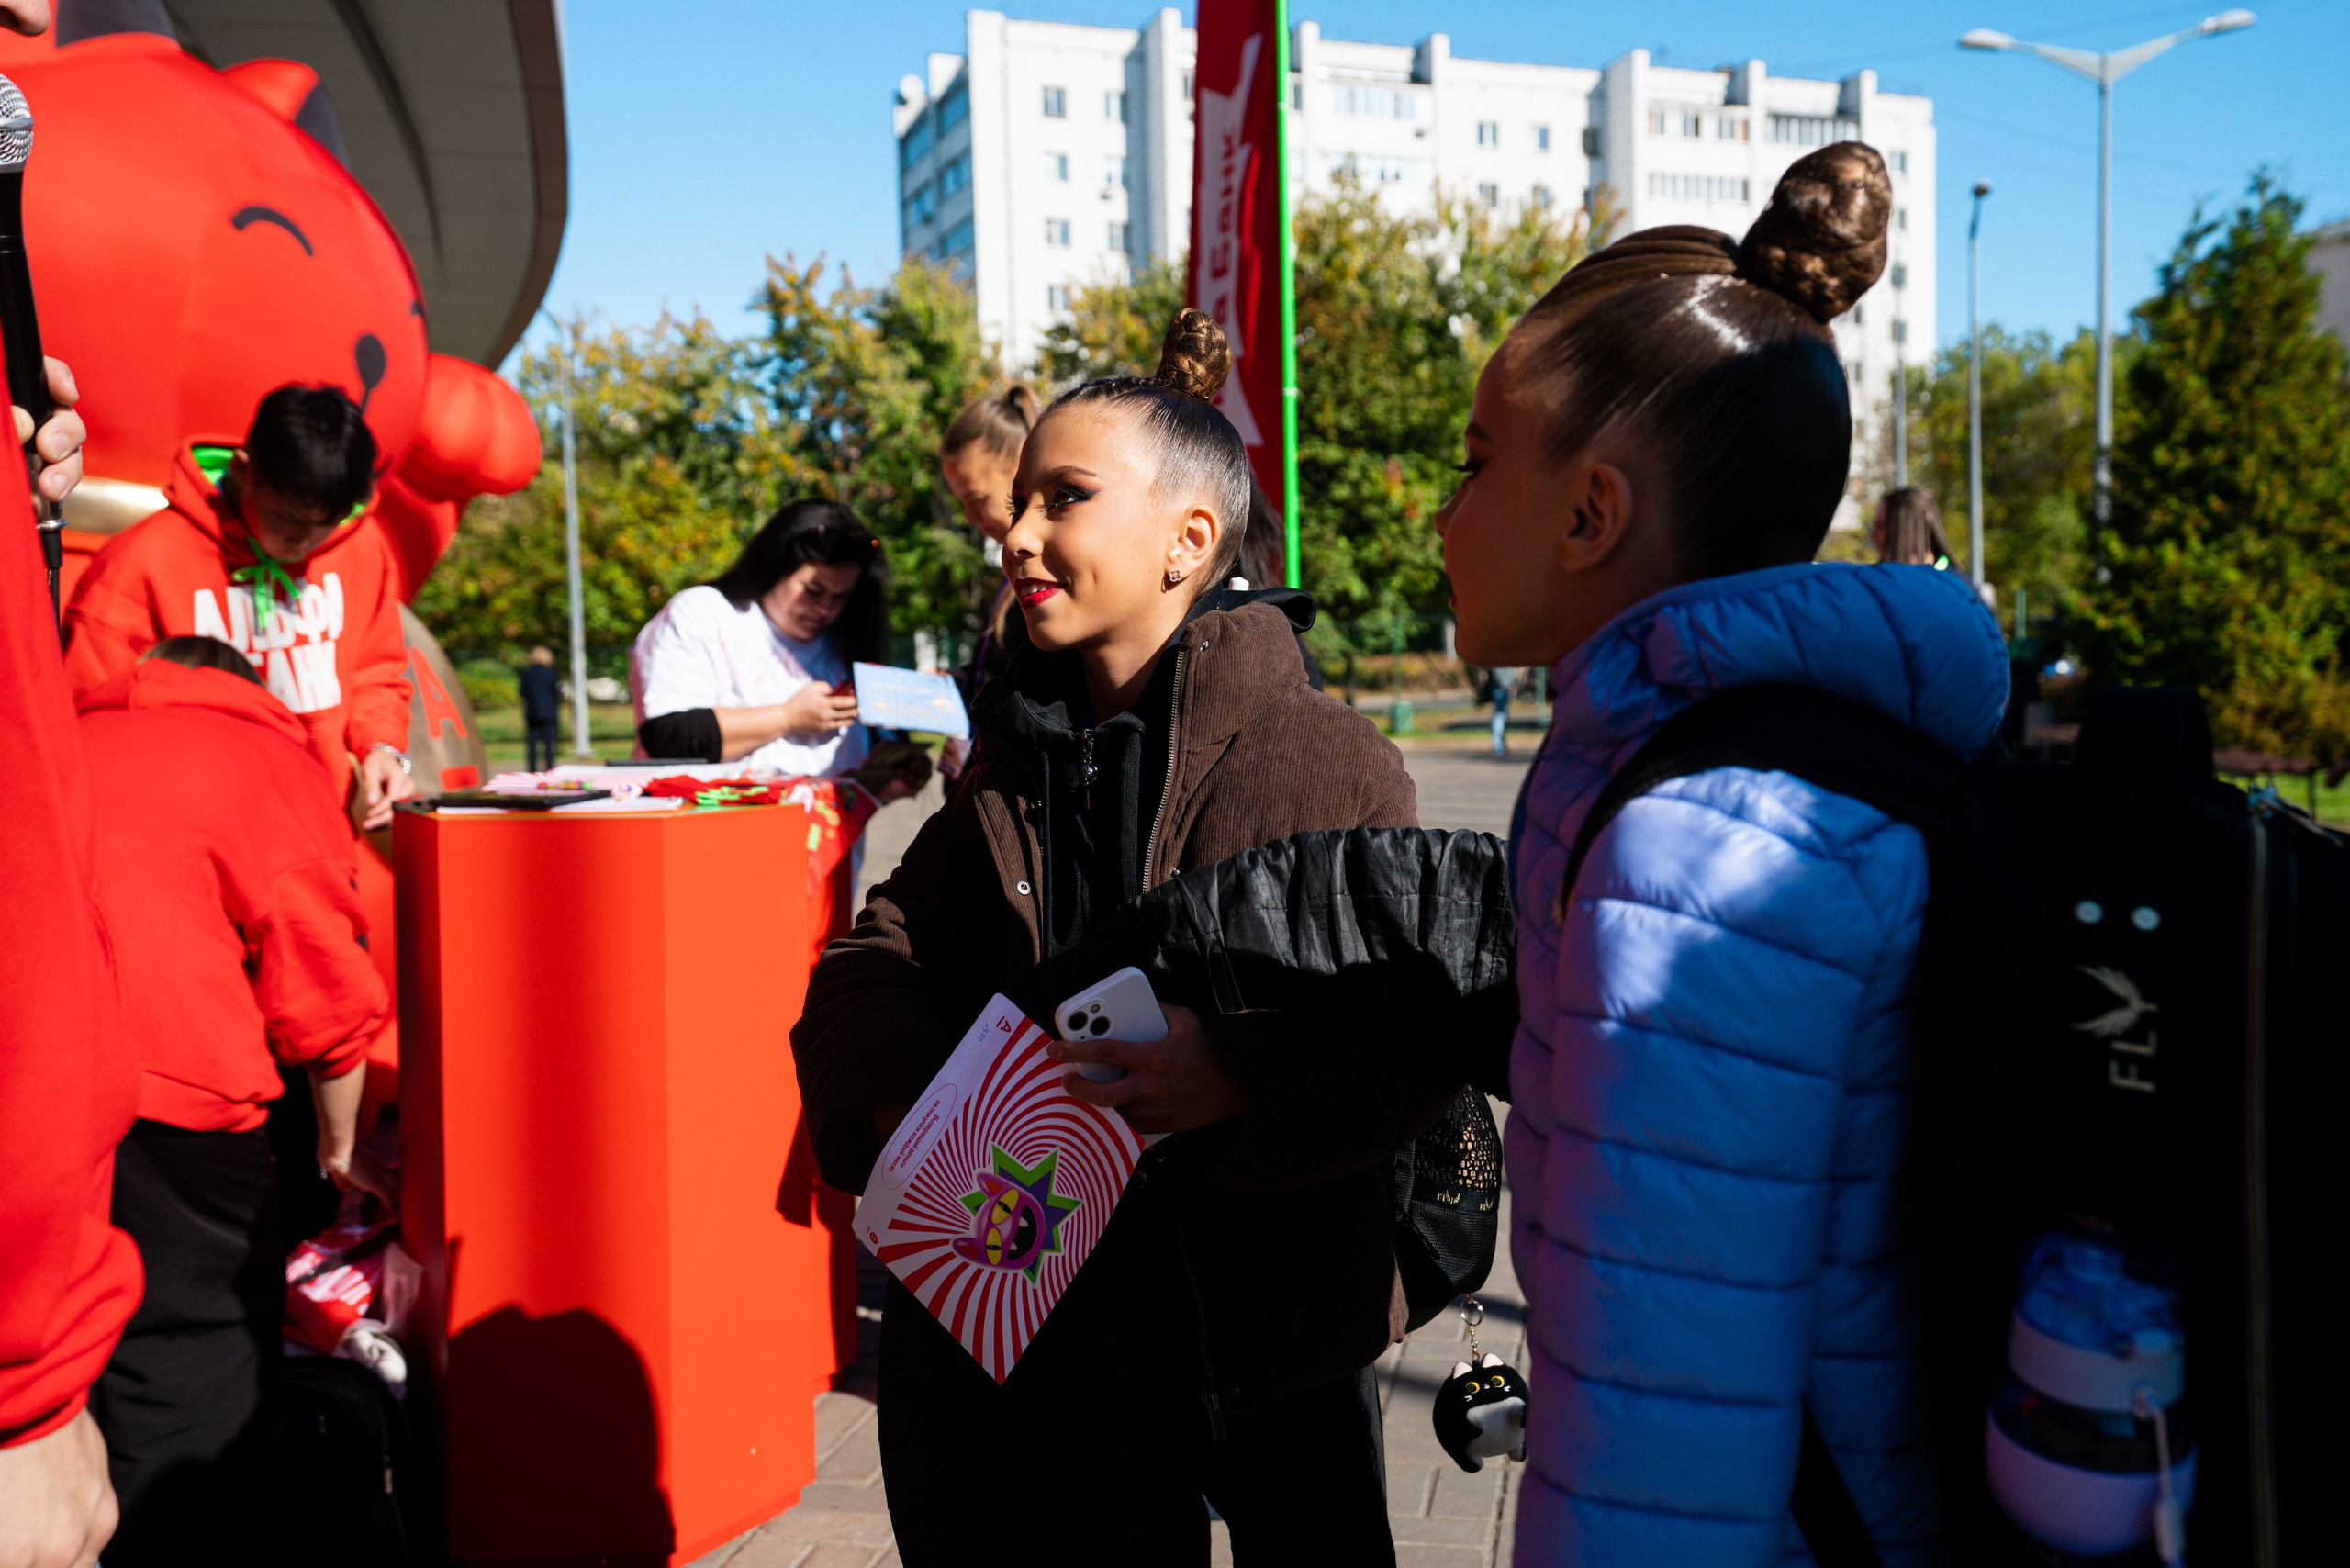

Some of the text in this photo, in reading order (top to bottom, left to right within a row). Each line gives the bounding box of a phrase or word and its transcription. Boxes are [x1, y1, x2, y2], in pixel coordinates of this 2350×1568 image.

[888, 1099, 941, 1172] за покупки каждый месяц
[900, 1114, 940, 1169] Возвращай деньги
